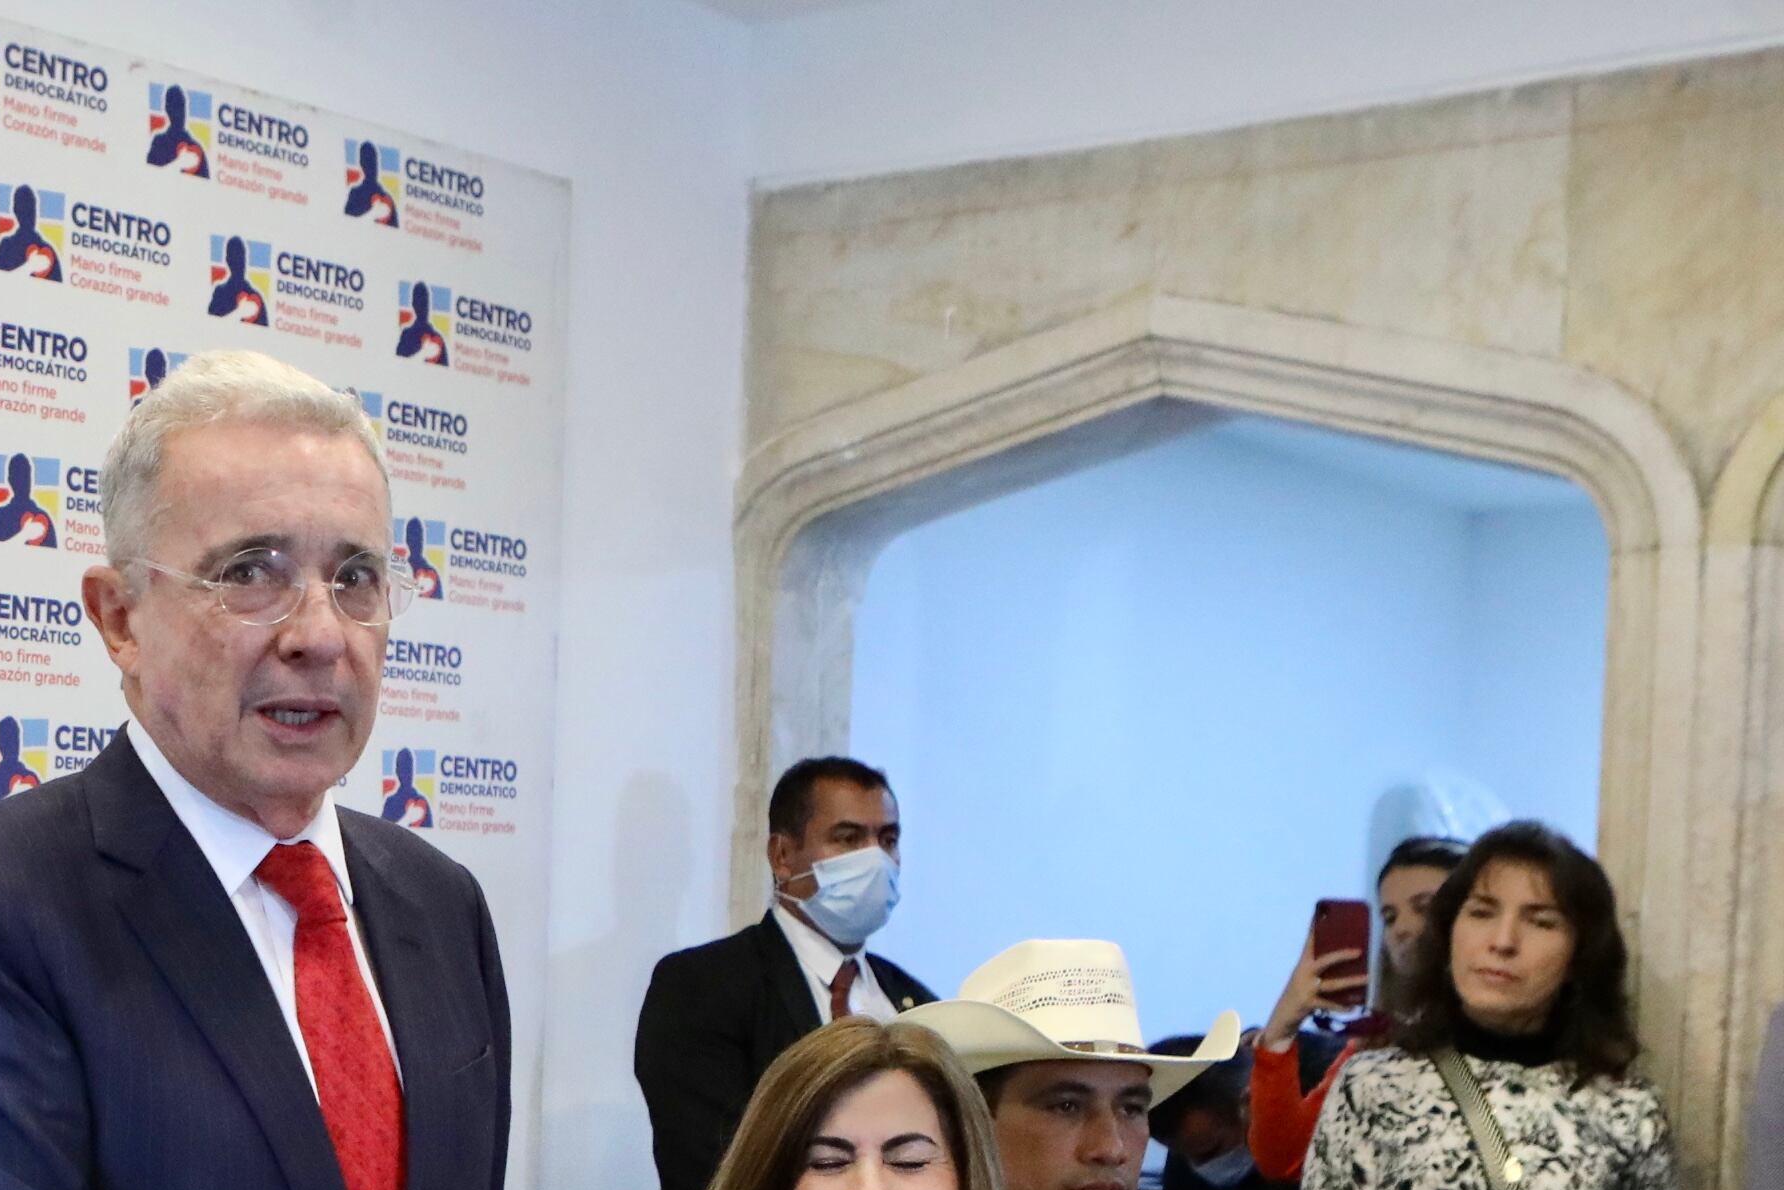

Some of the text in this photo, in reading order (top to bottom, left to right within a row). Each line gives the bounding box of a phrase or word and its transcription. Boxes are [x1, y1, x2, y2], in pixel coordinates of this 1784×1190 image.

[4, 43, 108, 93] CENTRO
[5, 73, 107, 112] DEMOCRÁTICO
[277, 252, 364, 293] CENTRO
[277, 280, 363, 311] DEMOCRÁTICO
[456, 296, 532, 334] CENTRO
[457, 322, 531, 351] DEMOCRÁTICO
[24, 381, 56, 399] firme
[42, 406, 86, 422] grande
[441, 755, 517, 782] CENTRO
[441, 782, 516, 799] DEMOCRÁTICO
